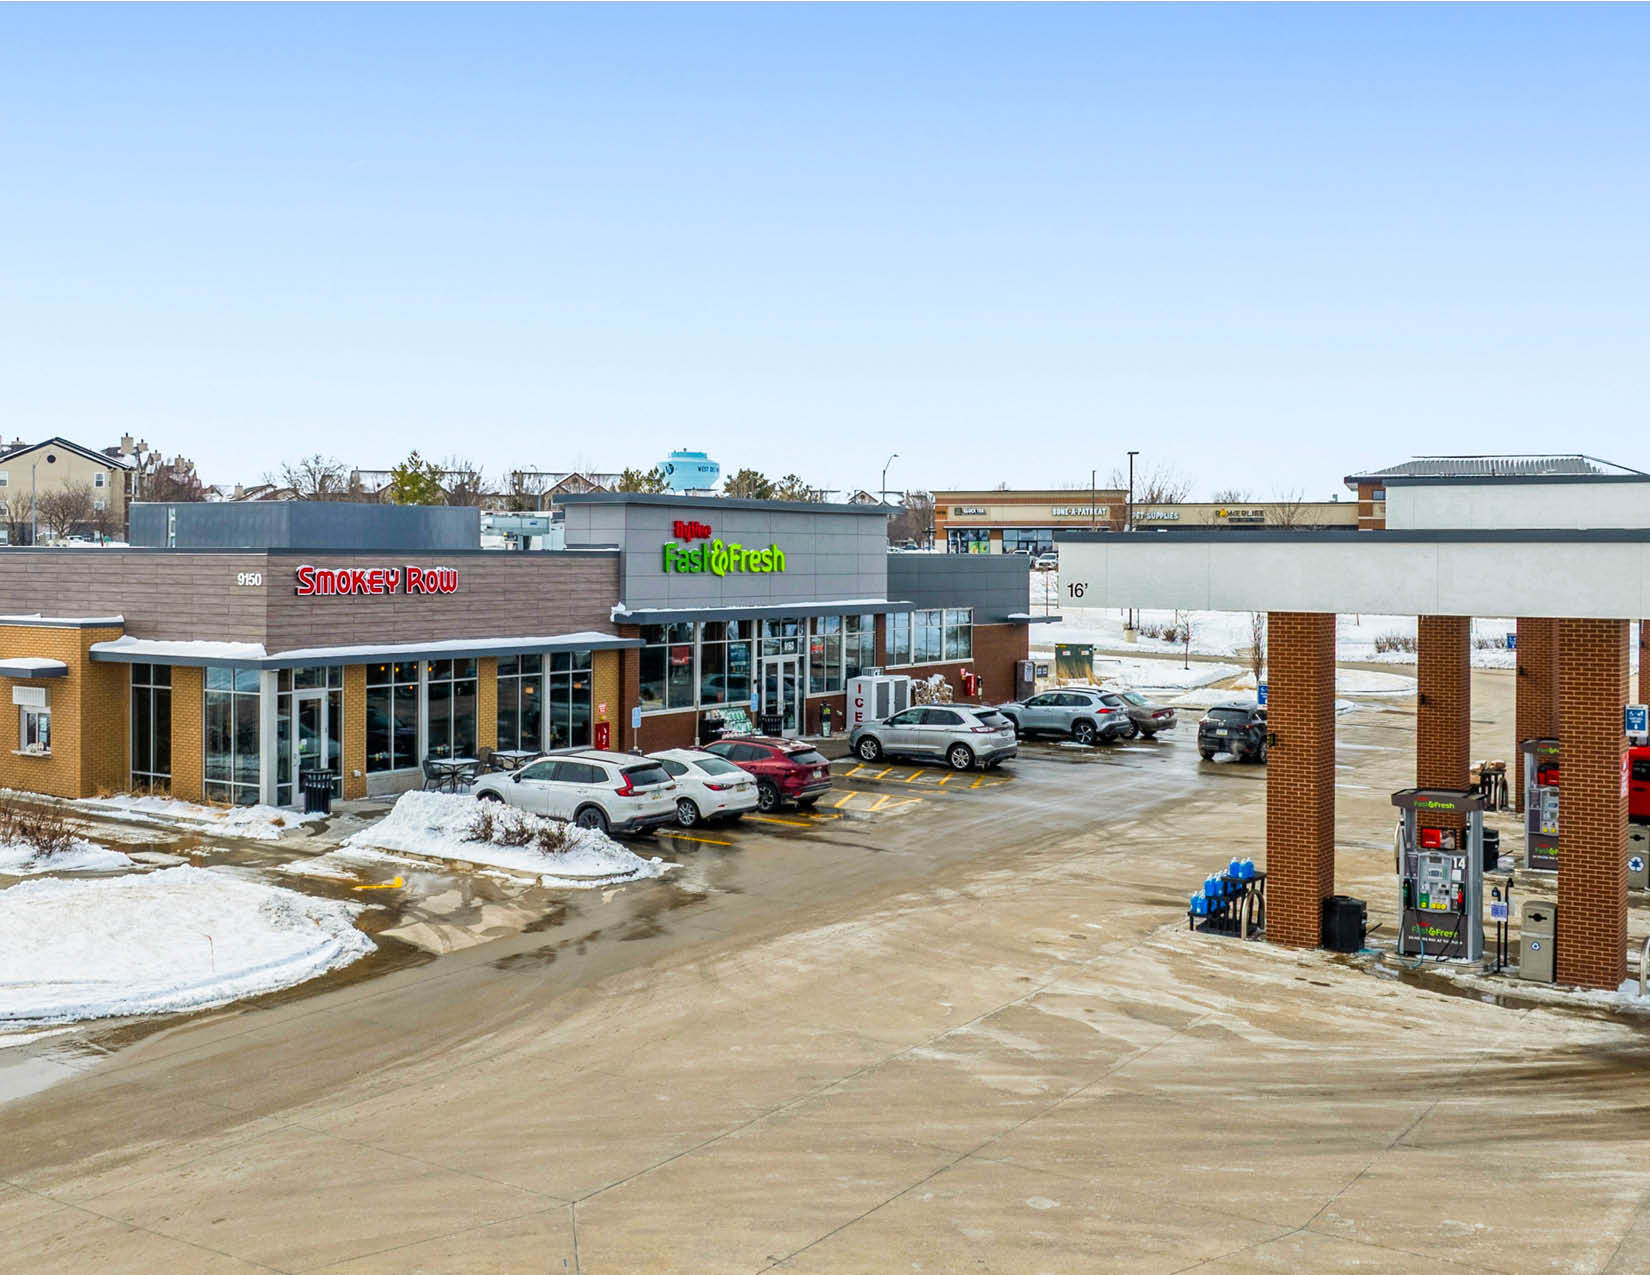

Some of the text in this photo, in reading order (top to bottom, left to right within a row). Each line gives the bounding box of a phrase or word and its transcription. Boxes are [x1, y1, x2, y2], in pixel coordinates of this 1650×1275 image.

[237, 572, 262, 587] 9150
[296, 565, 458, 596] SMOKEY ROW
[1453, 857, 1466, 870] 14
